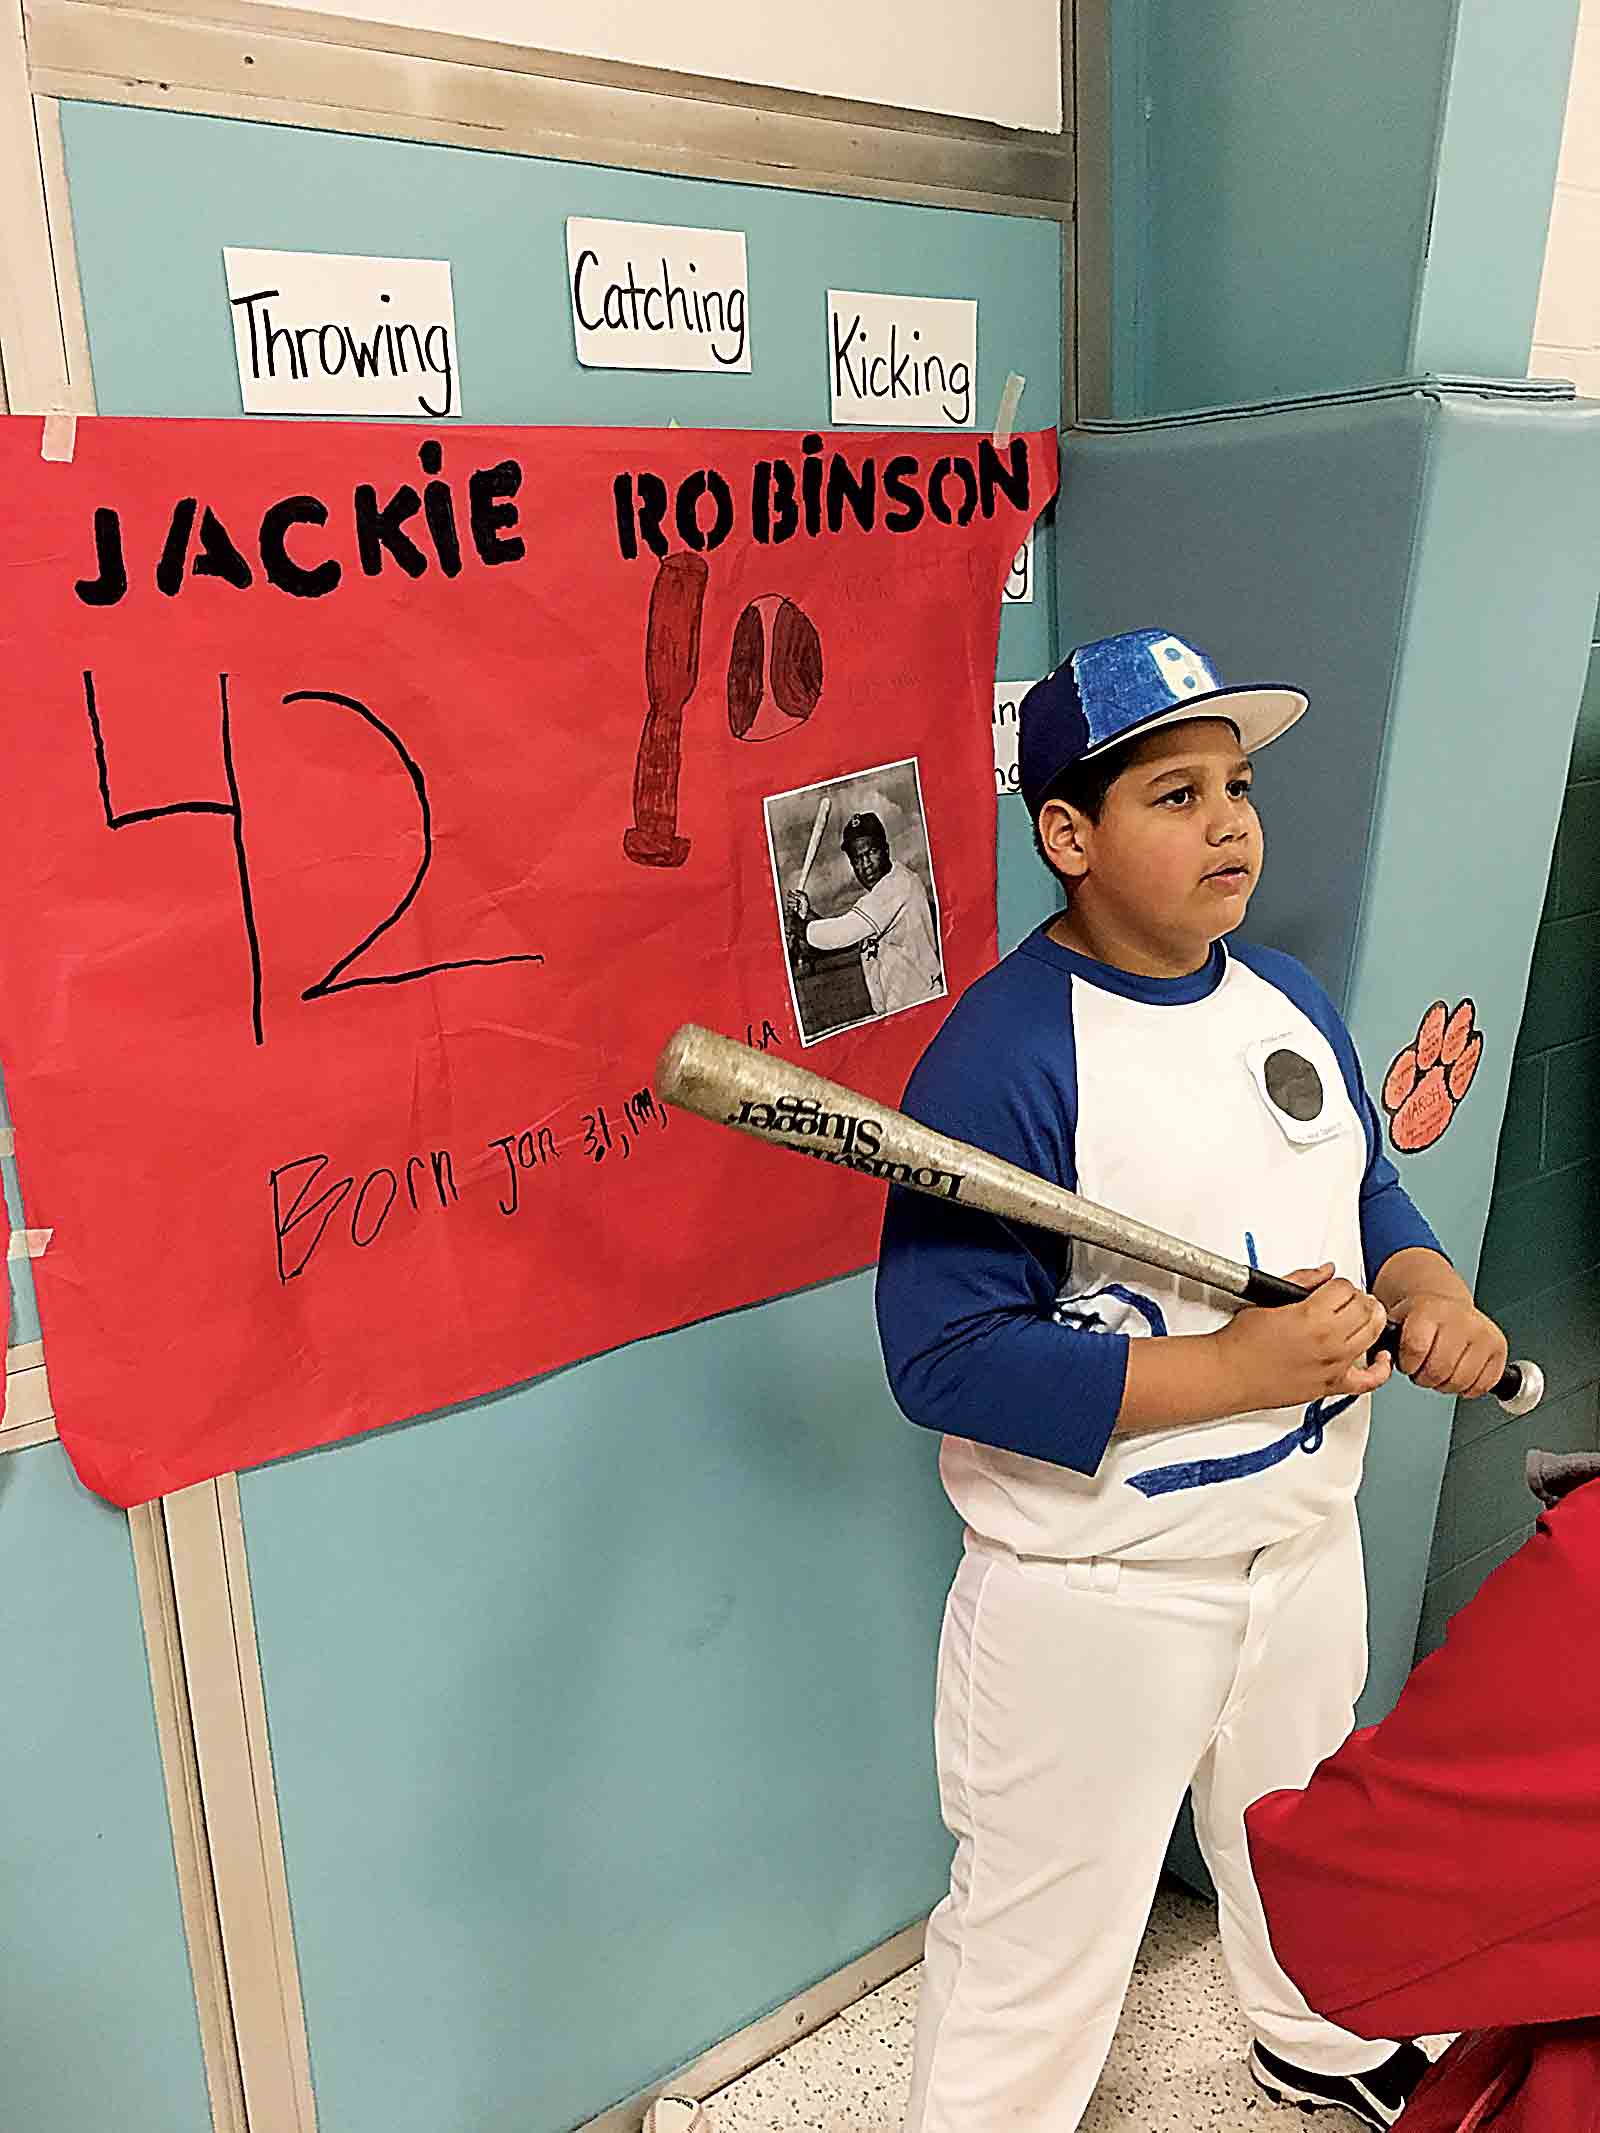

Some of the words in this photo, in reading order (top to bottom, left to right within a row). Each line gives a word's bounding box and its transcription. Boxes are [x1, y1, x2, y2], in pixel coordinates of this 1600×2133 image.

[229, 289, 453, 417] Throwing
[573, 249, 746, 365] Catching
[833, 311, 971, 425] Kicking
[84, 670, 545, 1045] 42
[727, 1095, 884, 1160] Slugger
[268, 1152, 459, 1285] Born
[488, 1125, 560, 1216] Jan
